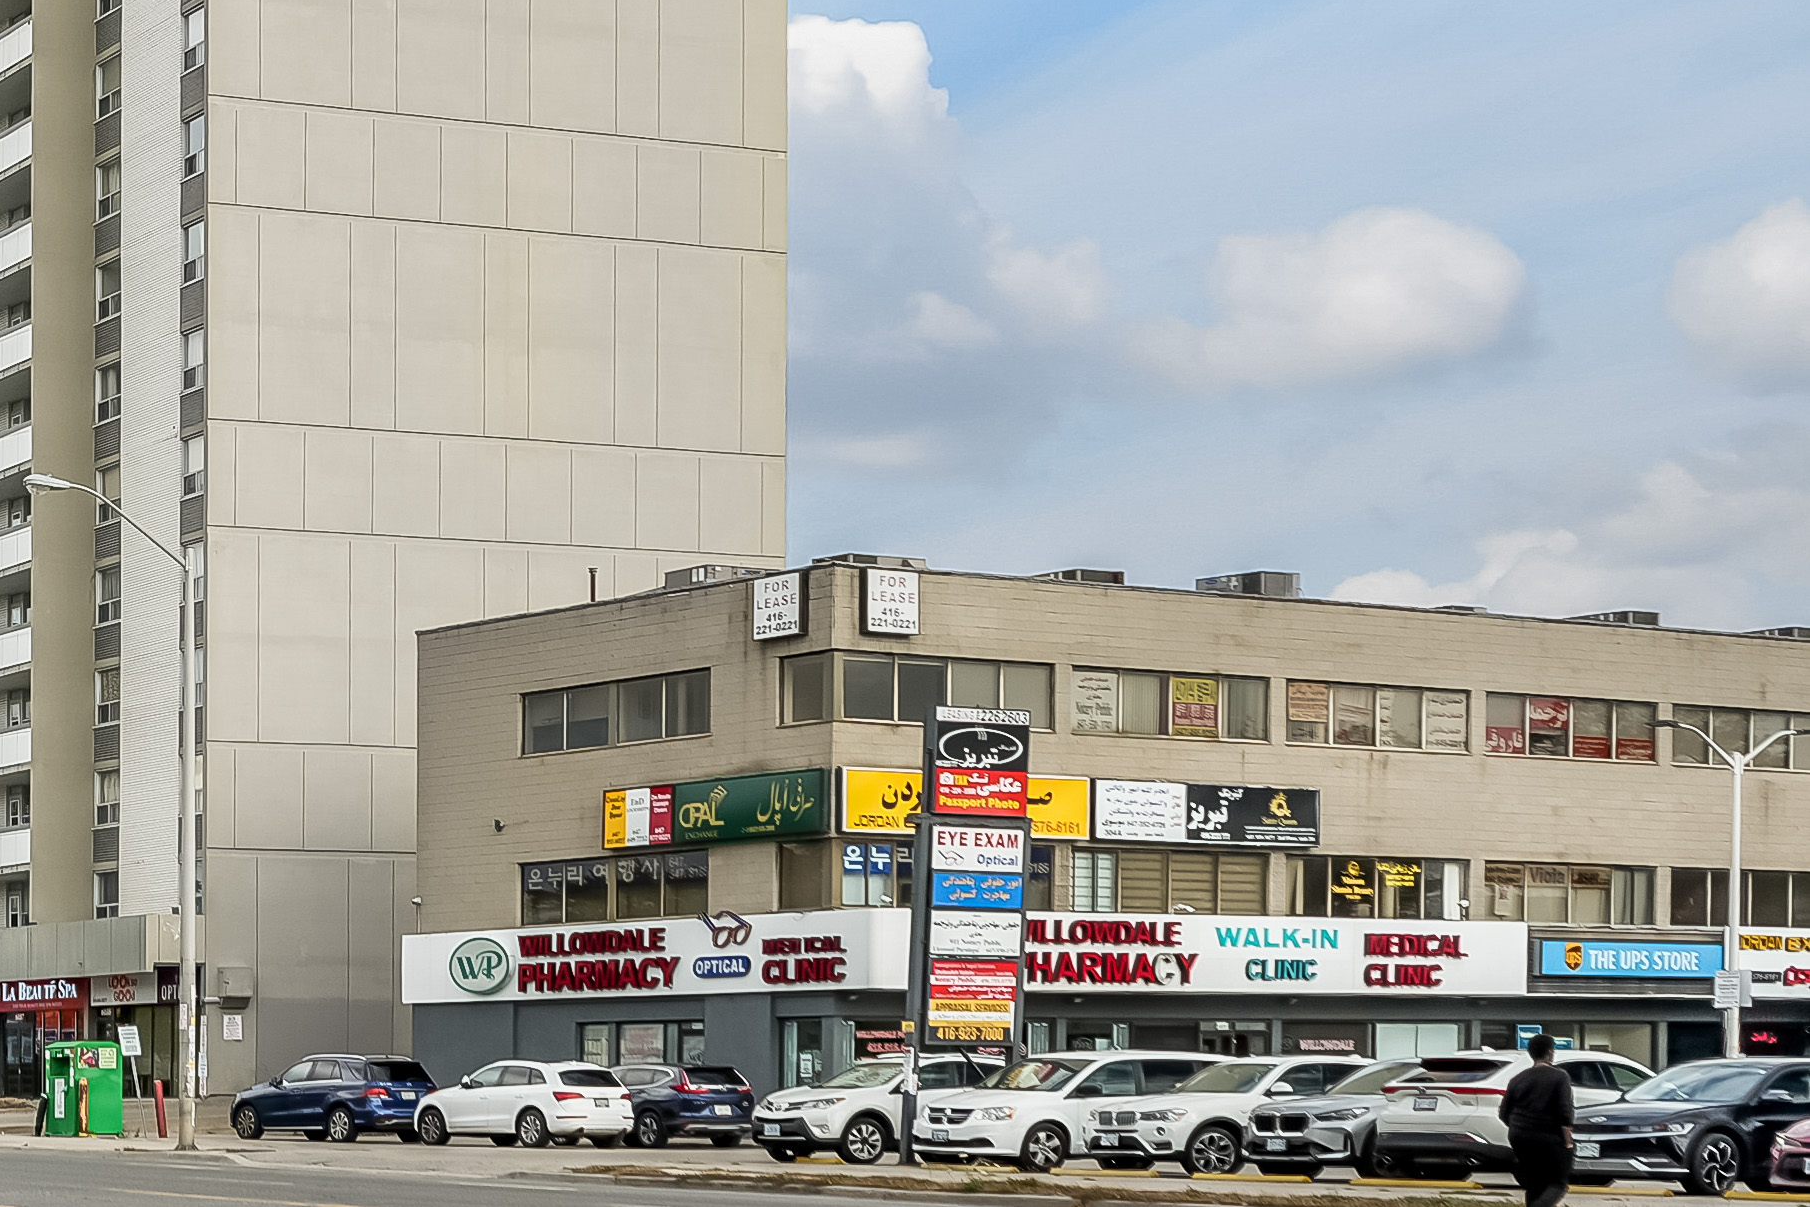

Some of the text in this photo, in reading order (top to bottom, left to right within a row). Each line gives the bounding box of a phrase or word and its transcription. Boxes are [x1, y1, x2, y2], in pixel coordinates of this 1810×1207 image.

[764, 580, 790, 594] FOR
[879, 575, 907, 589] FOR
[756, 593, 797, 610] LEASE
[871, 591, 916, 605] LEASE
[766, 611, 788, 623] 416-
[880, 607, 905, 617] 416-
[755, 620, 798, 636] 221-0221
[870, 617, 917, 630] 221-0221
[938, 795, 987, 809] Passport
[988, 798, 1021, 809] Photo
[679, 800, 726, 828] OPAL
[854, 814, 900, 829] JORDAN
[937, 831, 1018, 849] EYE EXAM
[977, 854, 1018, 867] Optical
[518, 927, 667, 958] WILLOWDALE
[1215, 927, 1339, 950] WALK-IN
[1364, 933, 1469, 958] MEDICAL
[456, 950, 503, 981] WP
[695, 958, 746, 975] OPTICAL
[1589, 950, 1700, 971] THE UPS STORE
[518, 956, 681, 993] PHARMACY
[762, 956, 848, 985] CLINIC
[1245, 958, 1319, 982] CLINIC
[1364, 963, 1444, 988] CLINIC
[2, 982, 16, 1002] LA
[58, 979, 78, 1000] SPA
